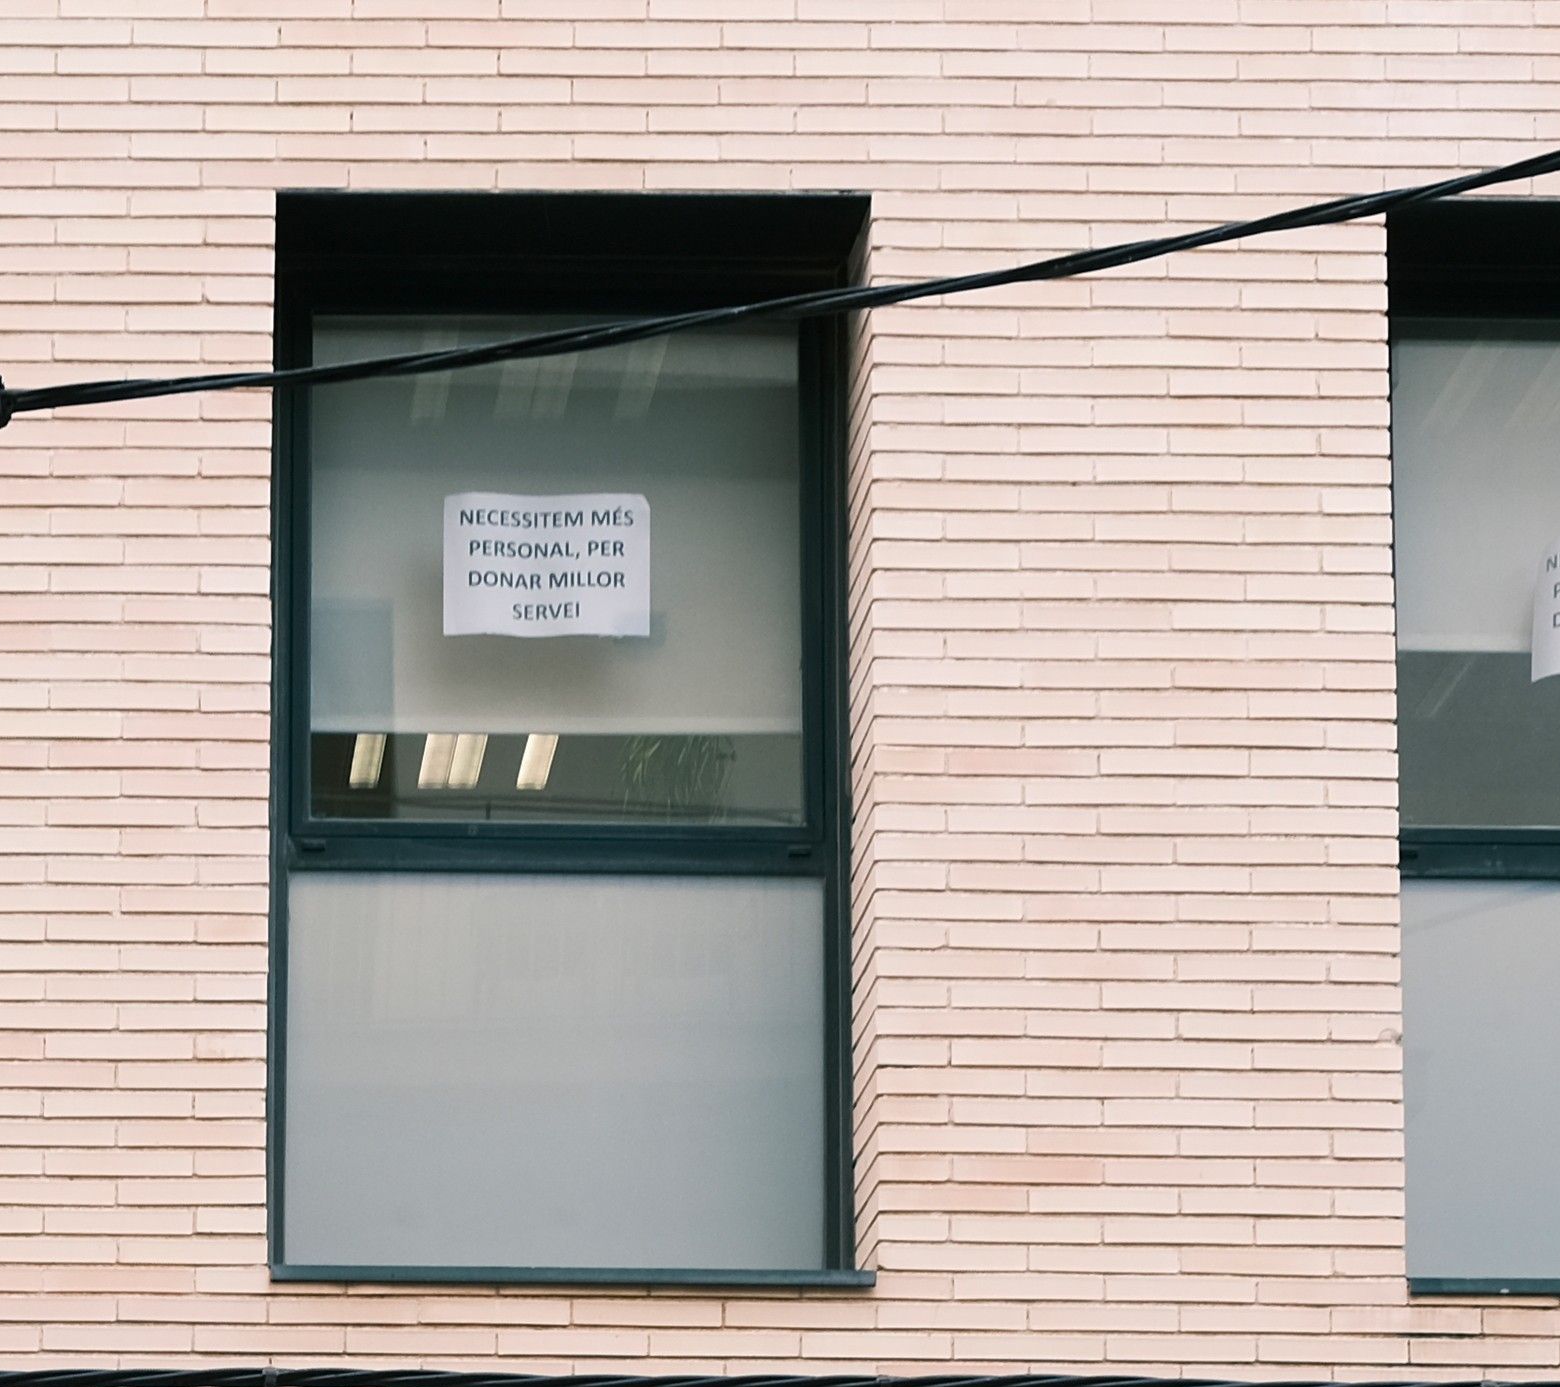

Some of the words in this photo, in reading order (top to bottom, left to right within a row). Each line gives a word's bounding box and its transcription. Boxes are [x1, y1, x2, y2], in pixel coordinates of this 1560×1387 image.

[460, 509, 583, 528] NECESSITEM
[591, 506, 634, 526] MÉS
[470, 540, 580, 559] PERSONAL,
[588, 541, 624, 556] PER
[468, 571, 541, 589] DONAR
[549, 571, 625, 588] MILLOR
[513, 603, 580, 620] SERVEI
